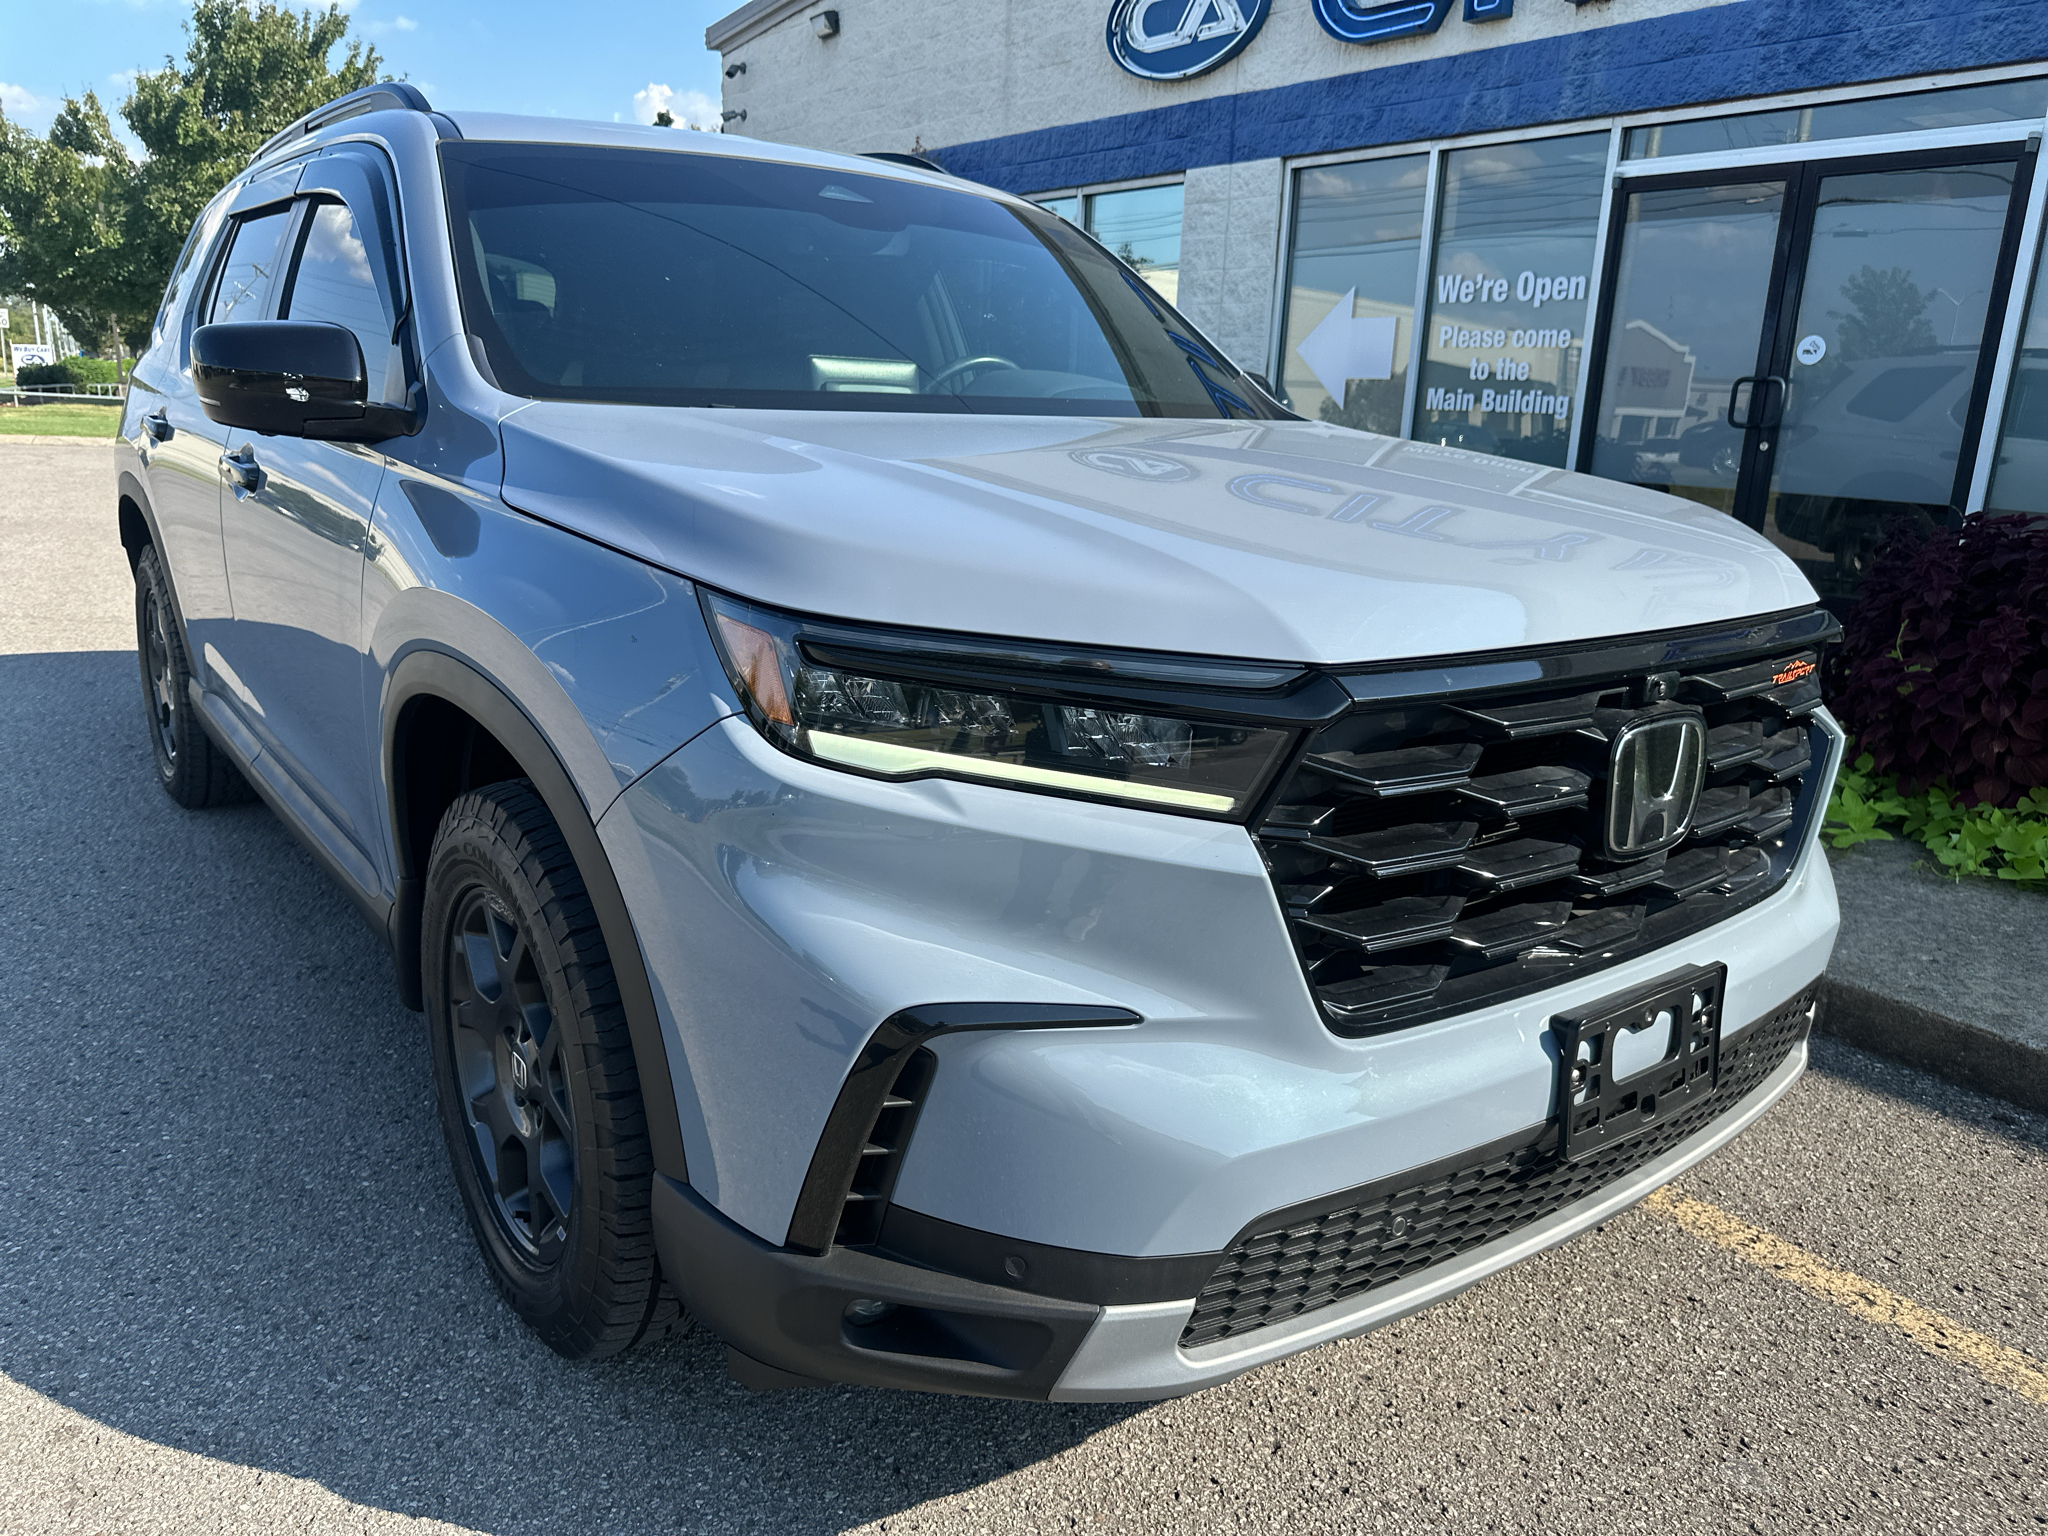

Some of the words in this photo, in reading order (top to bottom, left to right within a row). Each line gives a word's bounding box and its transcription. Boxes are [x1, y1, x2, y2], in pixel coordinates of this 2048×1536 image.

[1438, 273, 1508, 304] We're
[1516, 271, 1587, 308] Open
[1438, 325, 1506, 349] Please
[1511, 328, 1571, 349] come
[1469, 357, 1490, 381] to
[1495, 357, 1530, 382] the
[1425, 387, 1475, 412] Main
[1480, 388, 1570, 421] Building
